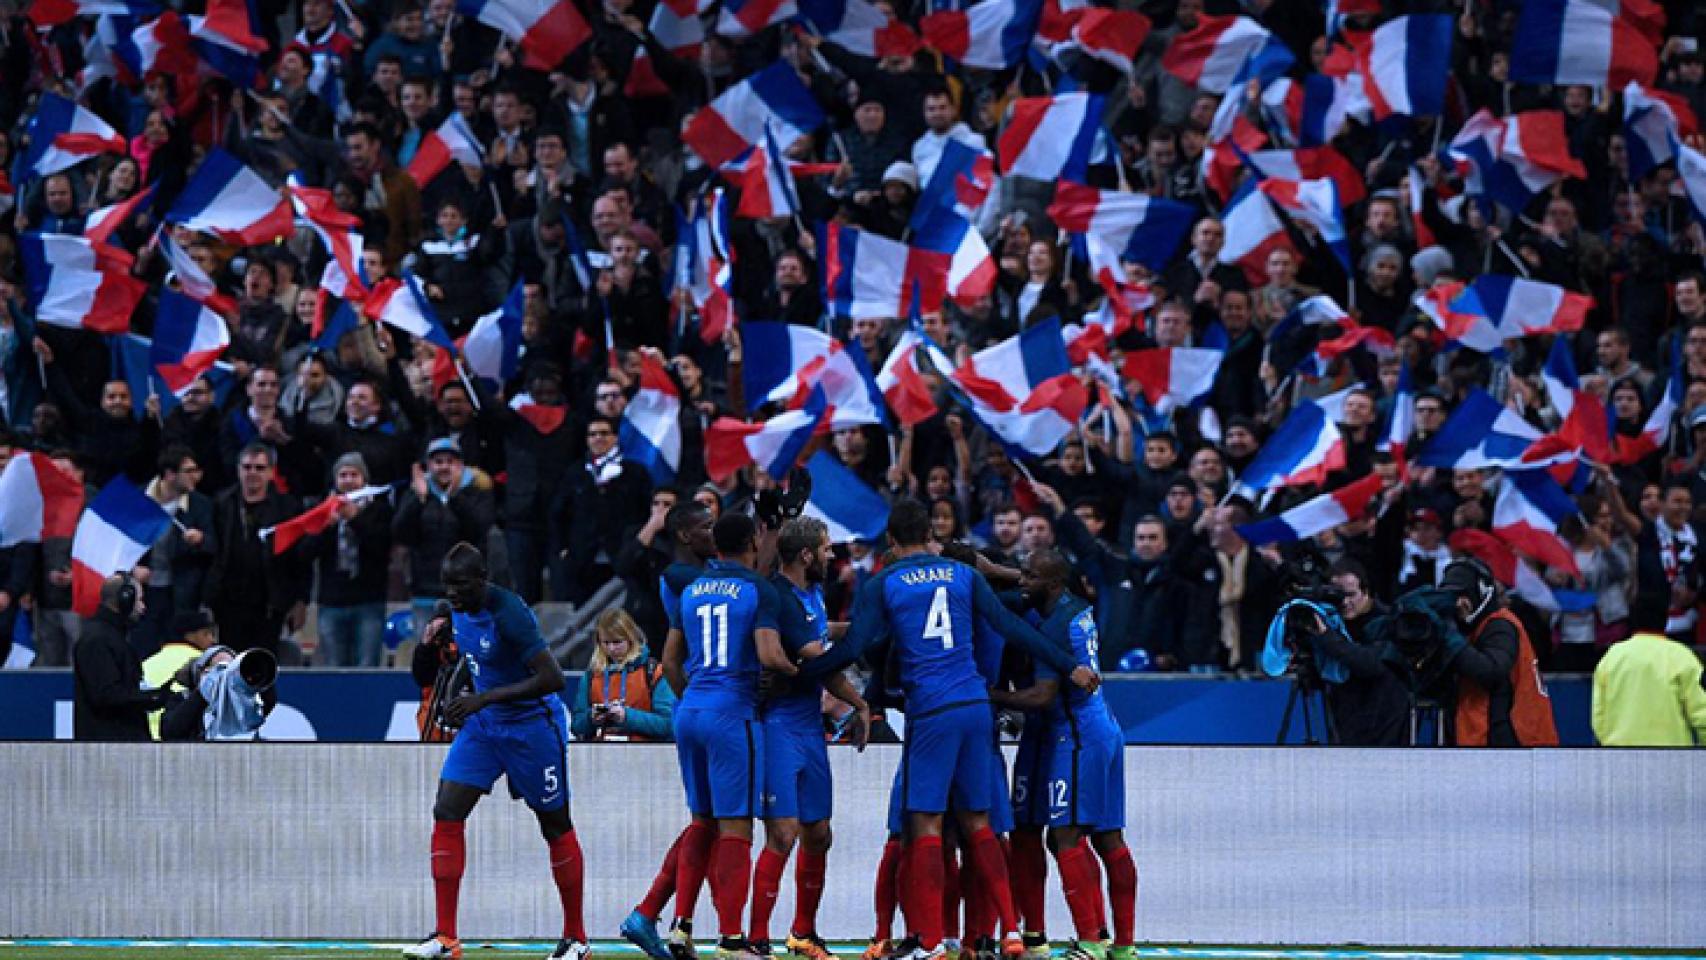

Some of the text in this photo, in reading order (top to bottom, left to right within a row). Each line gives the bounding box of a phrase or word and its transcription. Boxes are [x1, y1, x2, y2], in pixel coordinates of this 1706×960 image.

[691, 581, 742, 599] MARTIAL
[900, 568, 953, 586] VARANE
[923, 586, 954, 650] 4
[697, 603, 727, 667] 11
[544, 766, 558, 792] 5
[1048, 780, 1068, 807] 12
